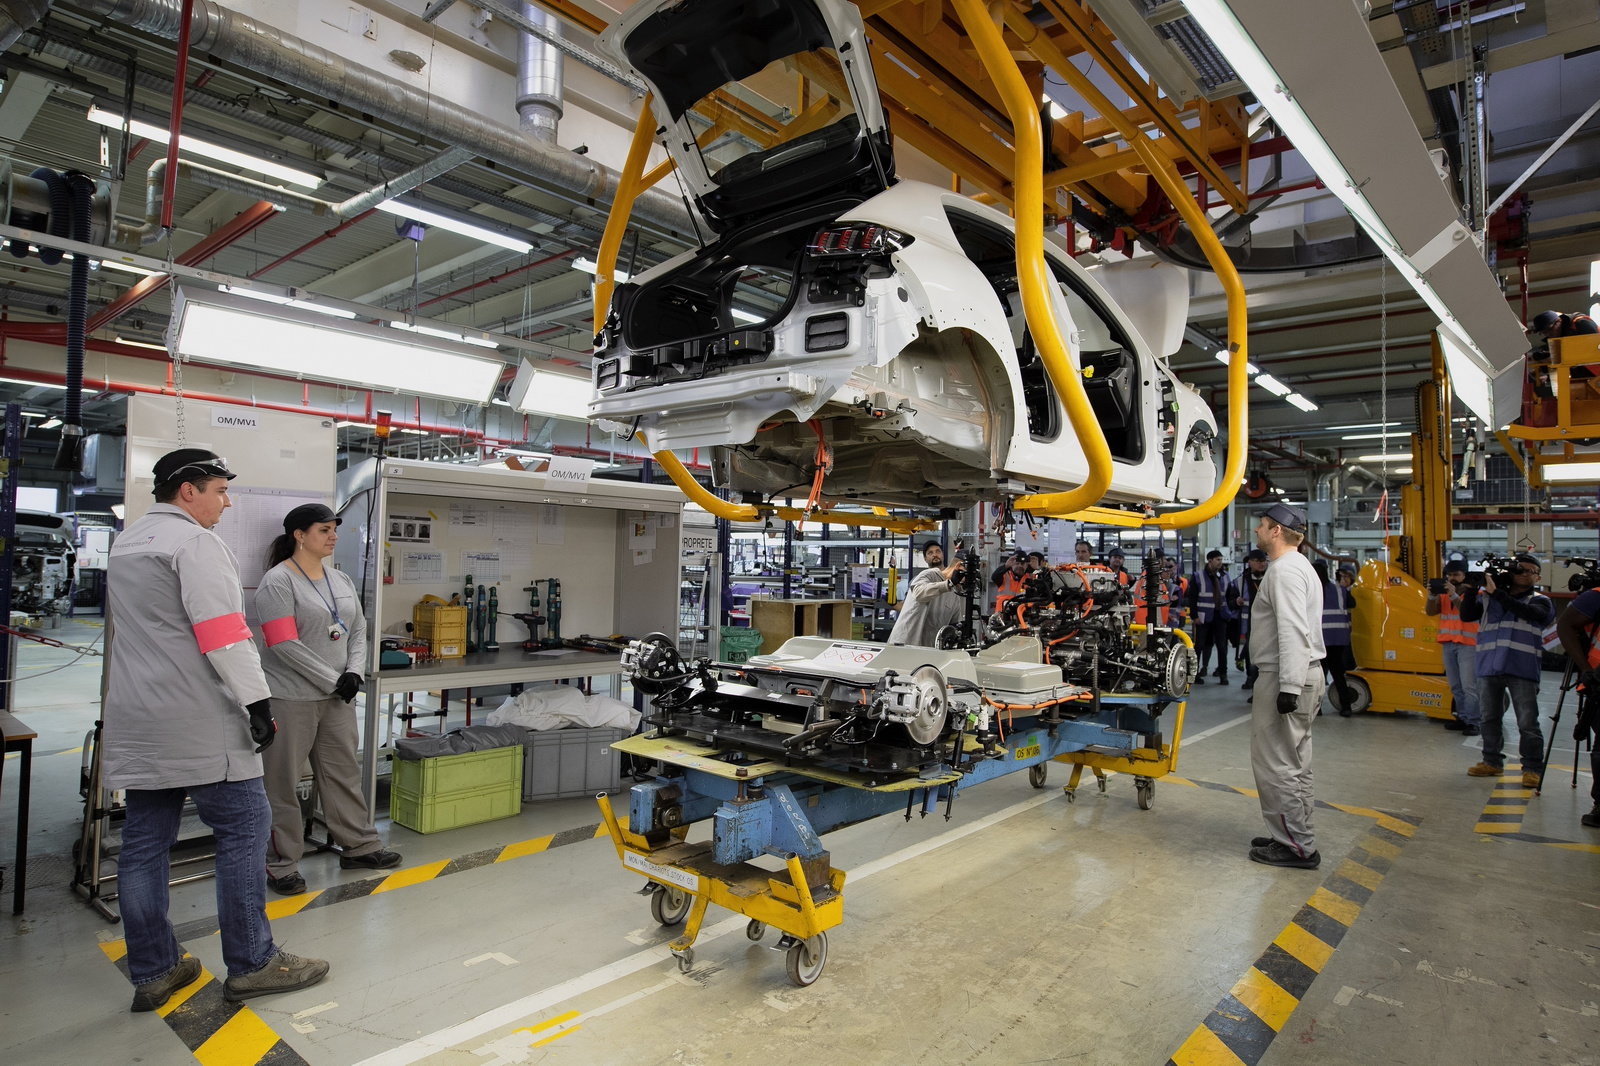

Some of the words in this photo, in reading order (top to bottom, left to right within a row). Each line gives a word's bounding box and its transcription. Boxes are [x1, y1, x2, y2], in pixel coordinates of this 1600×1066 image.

[217, 416, 256, 426] OM/MV1
[551, 469, 586, 480] OM/MV1
[681, 537, 713, 549] ROPRETE
[1410, 690, 1442, 699] TOUCAN
